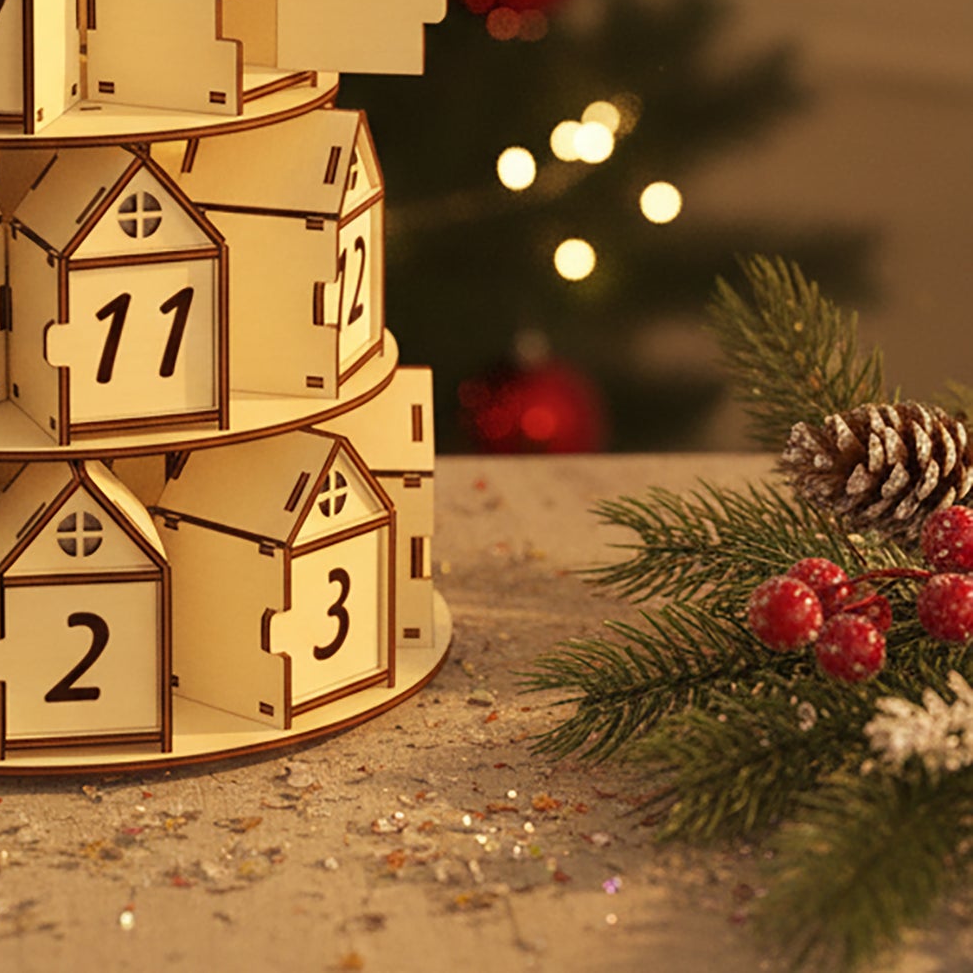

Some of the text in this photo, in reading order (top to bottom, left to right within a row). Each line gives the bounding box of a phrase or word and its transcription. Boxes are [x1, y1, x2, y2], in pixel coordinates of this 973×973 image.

[338, 235, 367, 330] 12
[95, 286, 196, 385] 11
[44, 611, 110, 704] 2
[313, 567, 351, 661] 3
